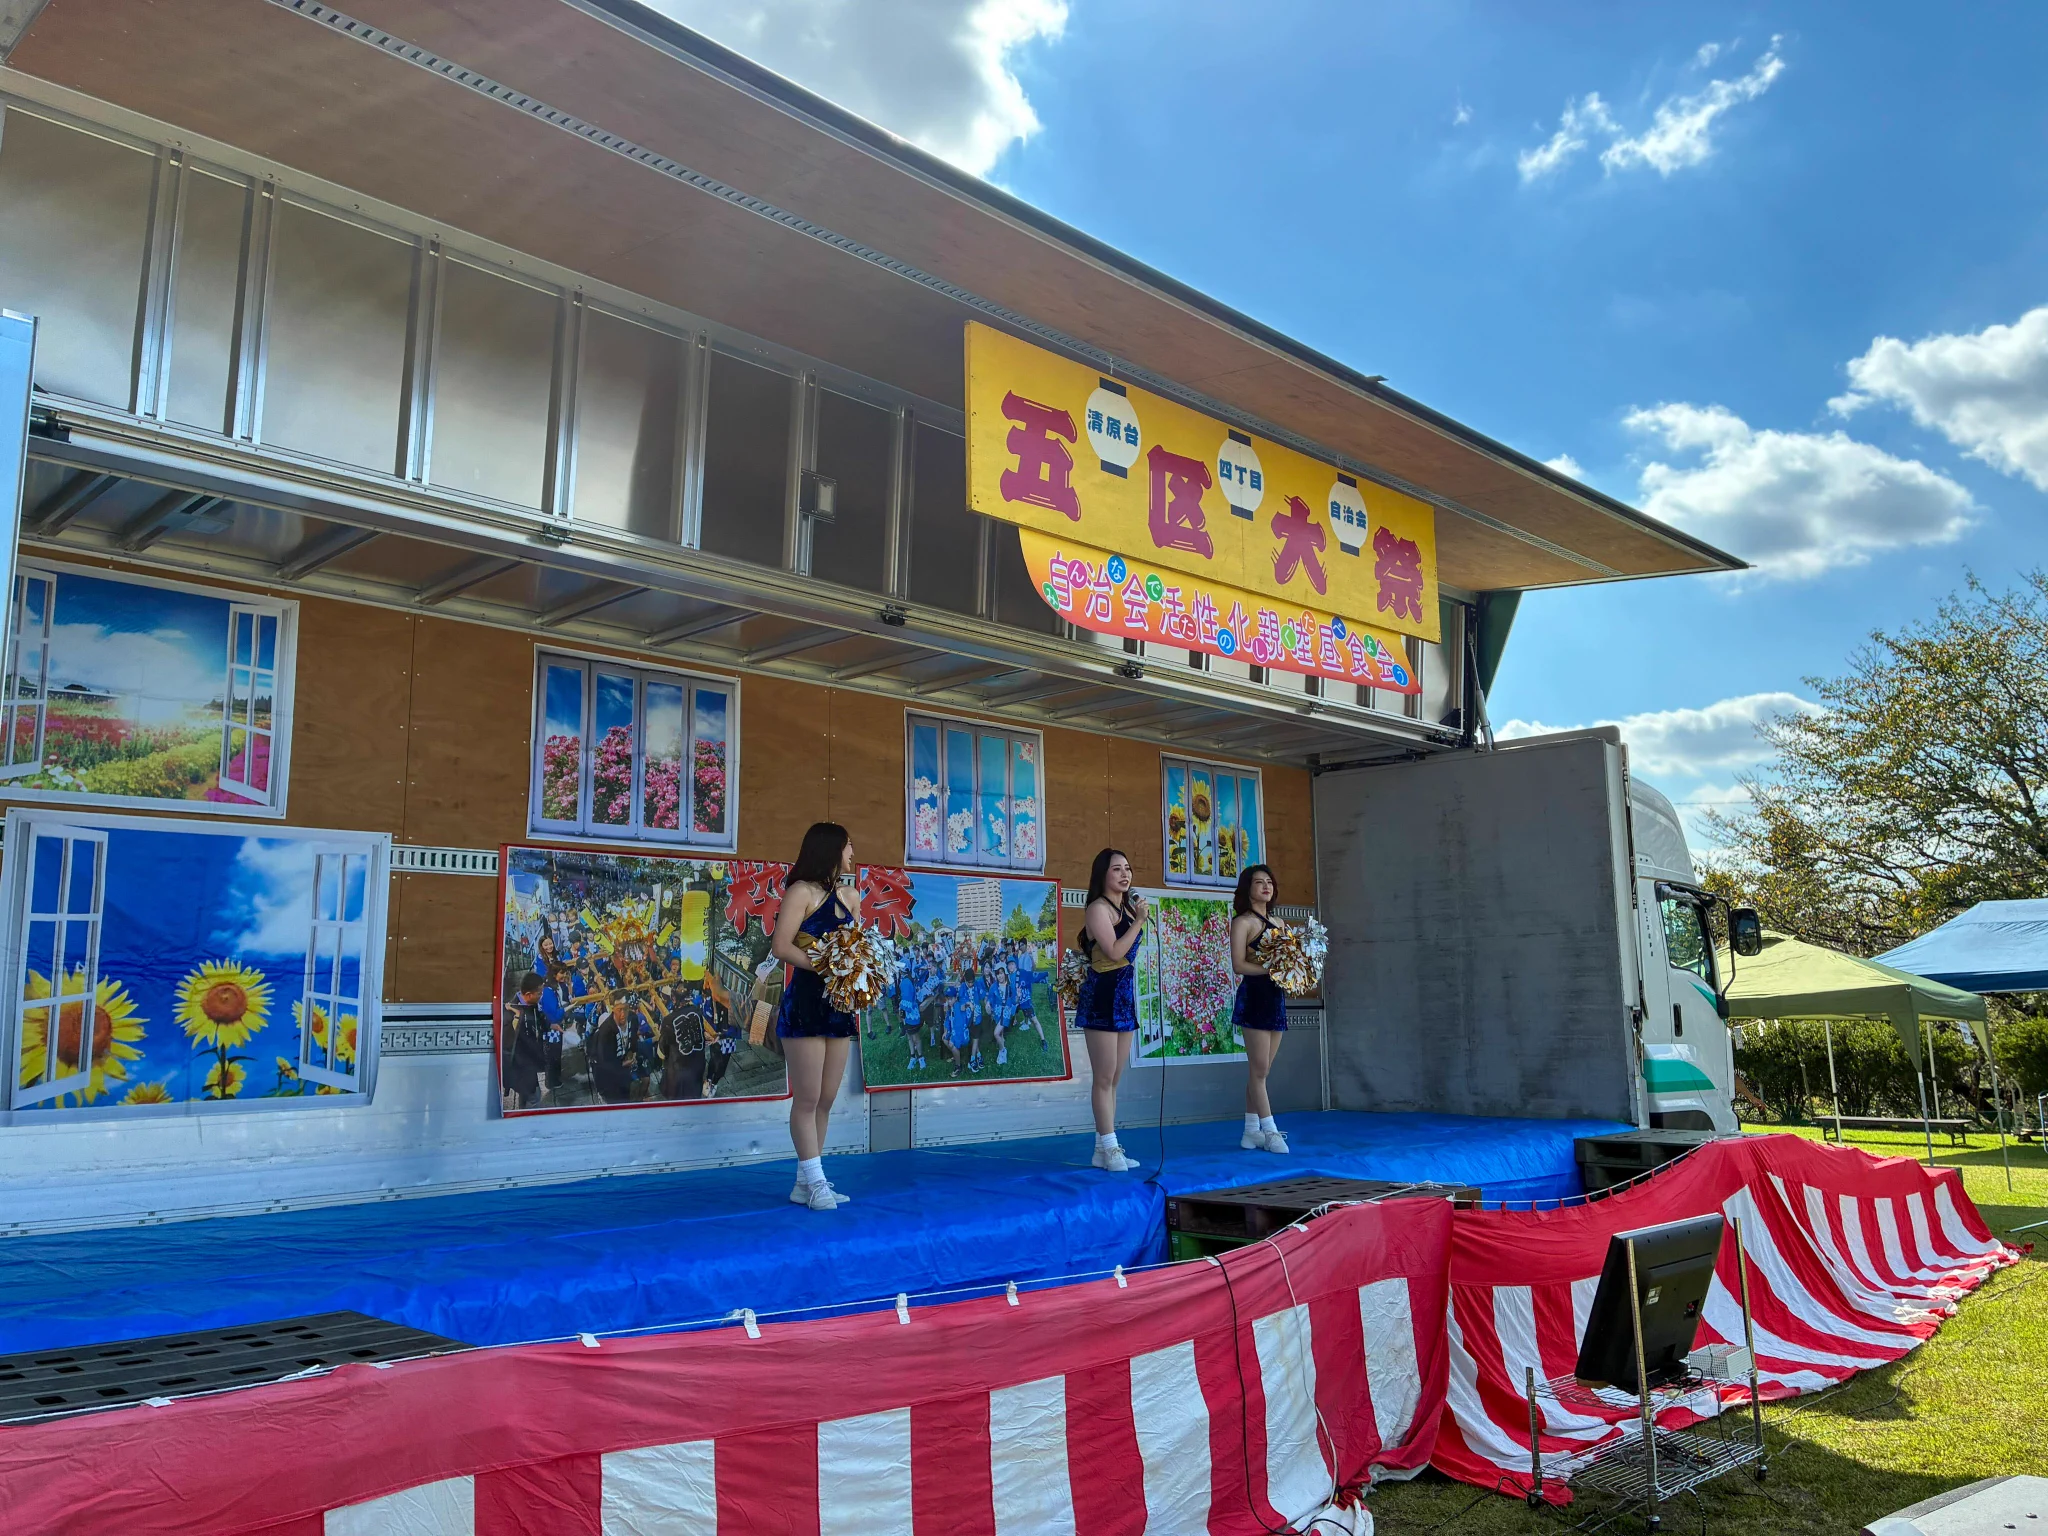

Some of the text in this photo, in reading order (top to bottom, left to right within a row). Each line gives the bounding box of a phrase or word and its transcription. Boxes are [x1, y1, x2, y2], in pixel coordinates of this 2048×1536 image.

[1087, 408, 1139, 447] 清原台
[1219, 458, 1262, 491] 四丁目
[1000, 389, 1423, 623] 五区大祭
[1330, 500, 1367, 529] 自治会
